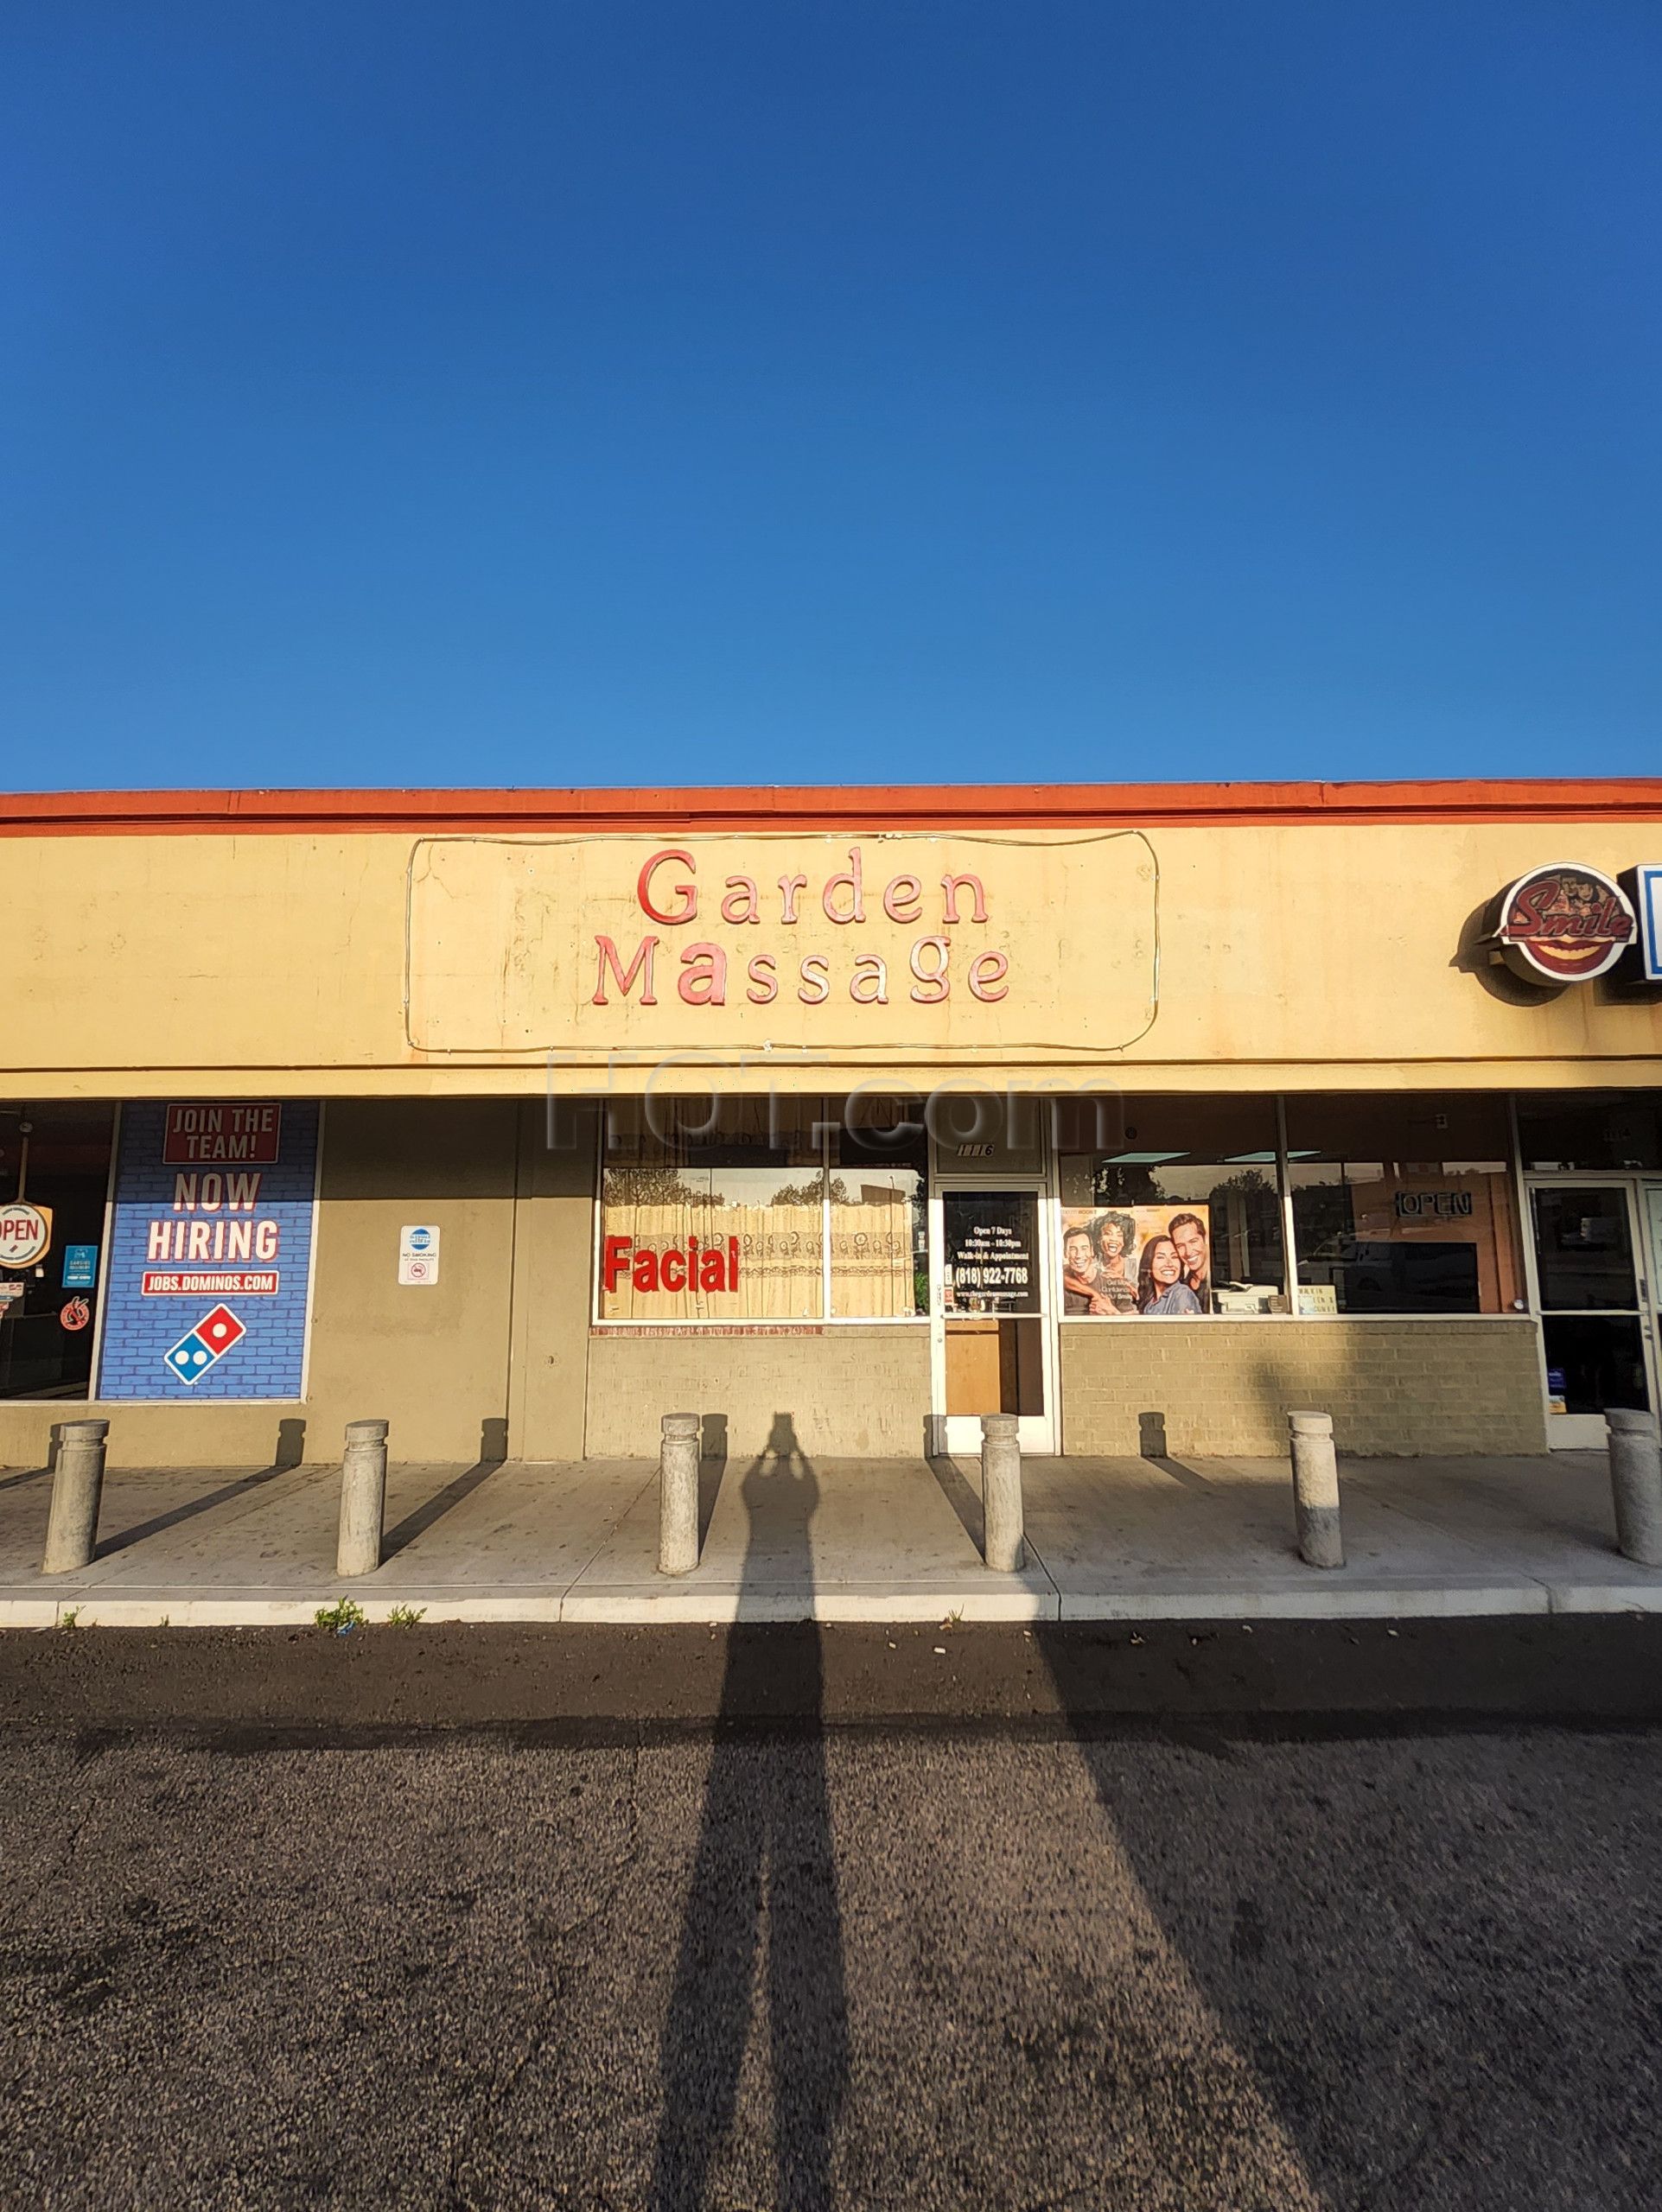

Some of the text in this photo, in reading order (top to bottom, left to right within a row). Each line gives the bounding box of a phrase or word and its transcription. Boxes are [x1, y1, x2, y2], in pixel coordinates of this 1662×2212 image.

[637, 847, 990, 925] Garden
[1500, 880, 1633, 936] Smile
[592, 935, 1009, 1007] Massage
[173, 1109, 274, 1133] JOIN THE
[187, 1135, 257, 1159] TEAM!
[960, 1144, 994, 1156] 1116
[173, 1173, 262, 1211] NOW
[1403, 1194, 1469, 1213] OPEN
[0, 1219, 39, 1241] PEN
[147, 1220, 279, 1262] HIRING
[973, 1227, 990, 1236] Open
[997, 1227, 1012, 1236] Days
[604, 1235, 739, 1294] Facial
[148, 1275, 273, 1292] JOBS.DOMINOS.COM
[956, 1267, 981, 1288] (818)
[983, 1267, 1028, 1284] 922-7768
